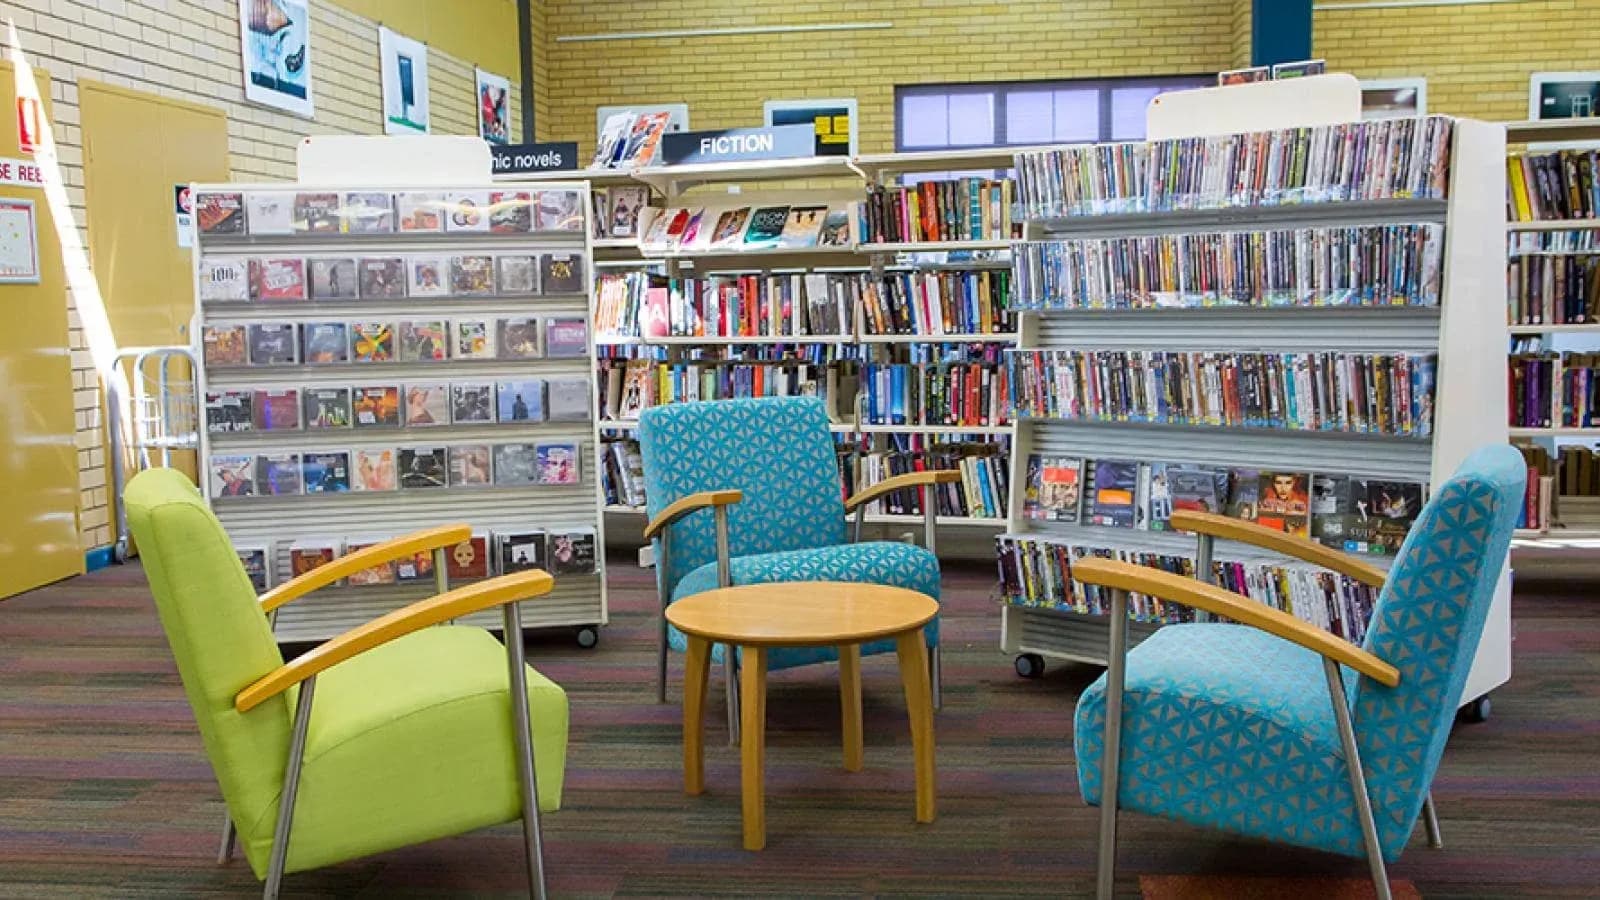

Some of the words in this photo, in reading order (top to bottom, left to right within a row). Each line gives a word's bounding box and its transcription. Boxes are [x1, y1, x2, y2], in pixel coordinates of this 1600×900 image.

[700, 133, 774, 156] FICTION
[515, 150, 562, 168] novels
[18, 165, 45, 184] REE
